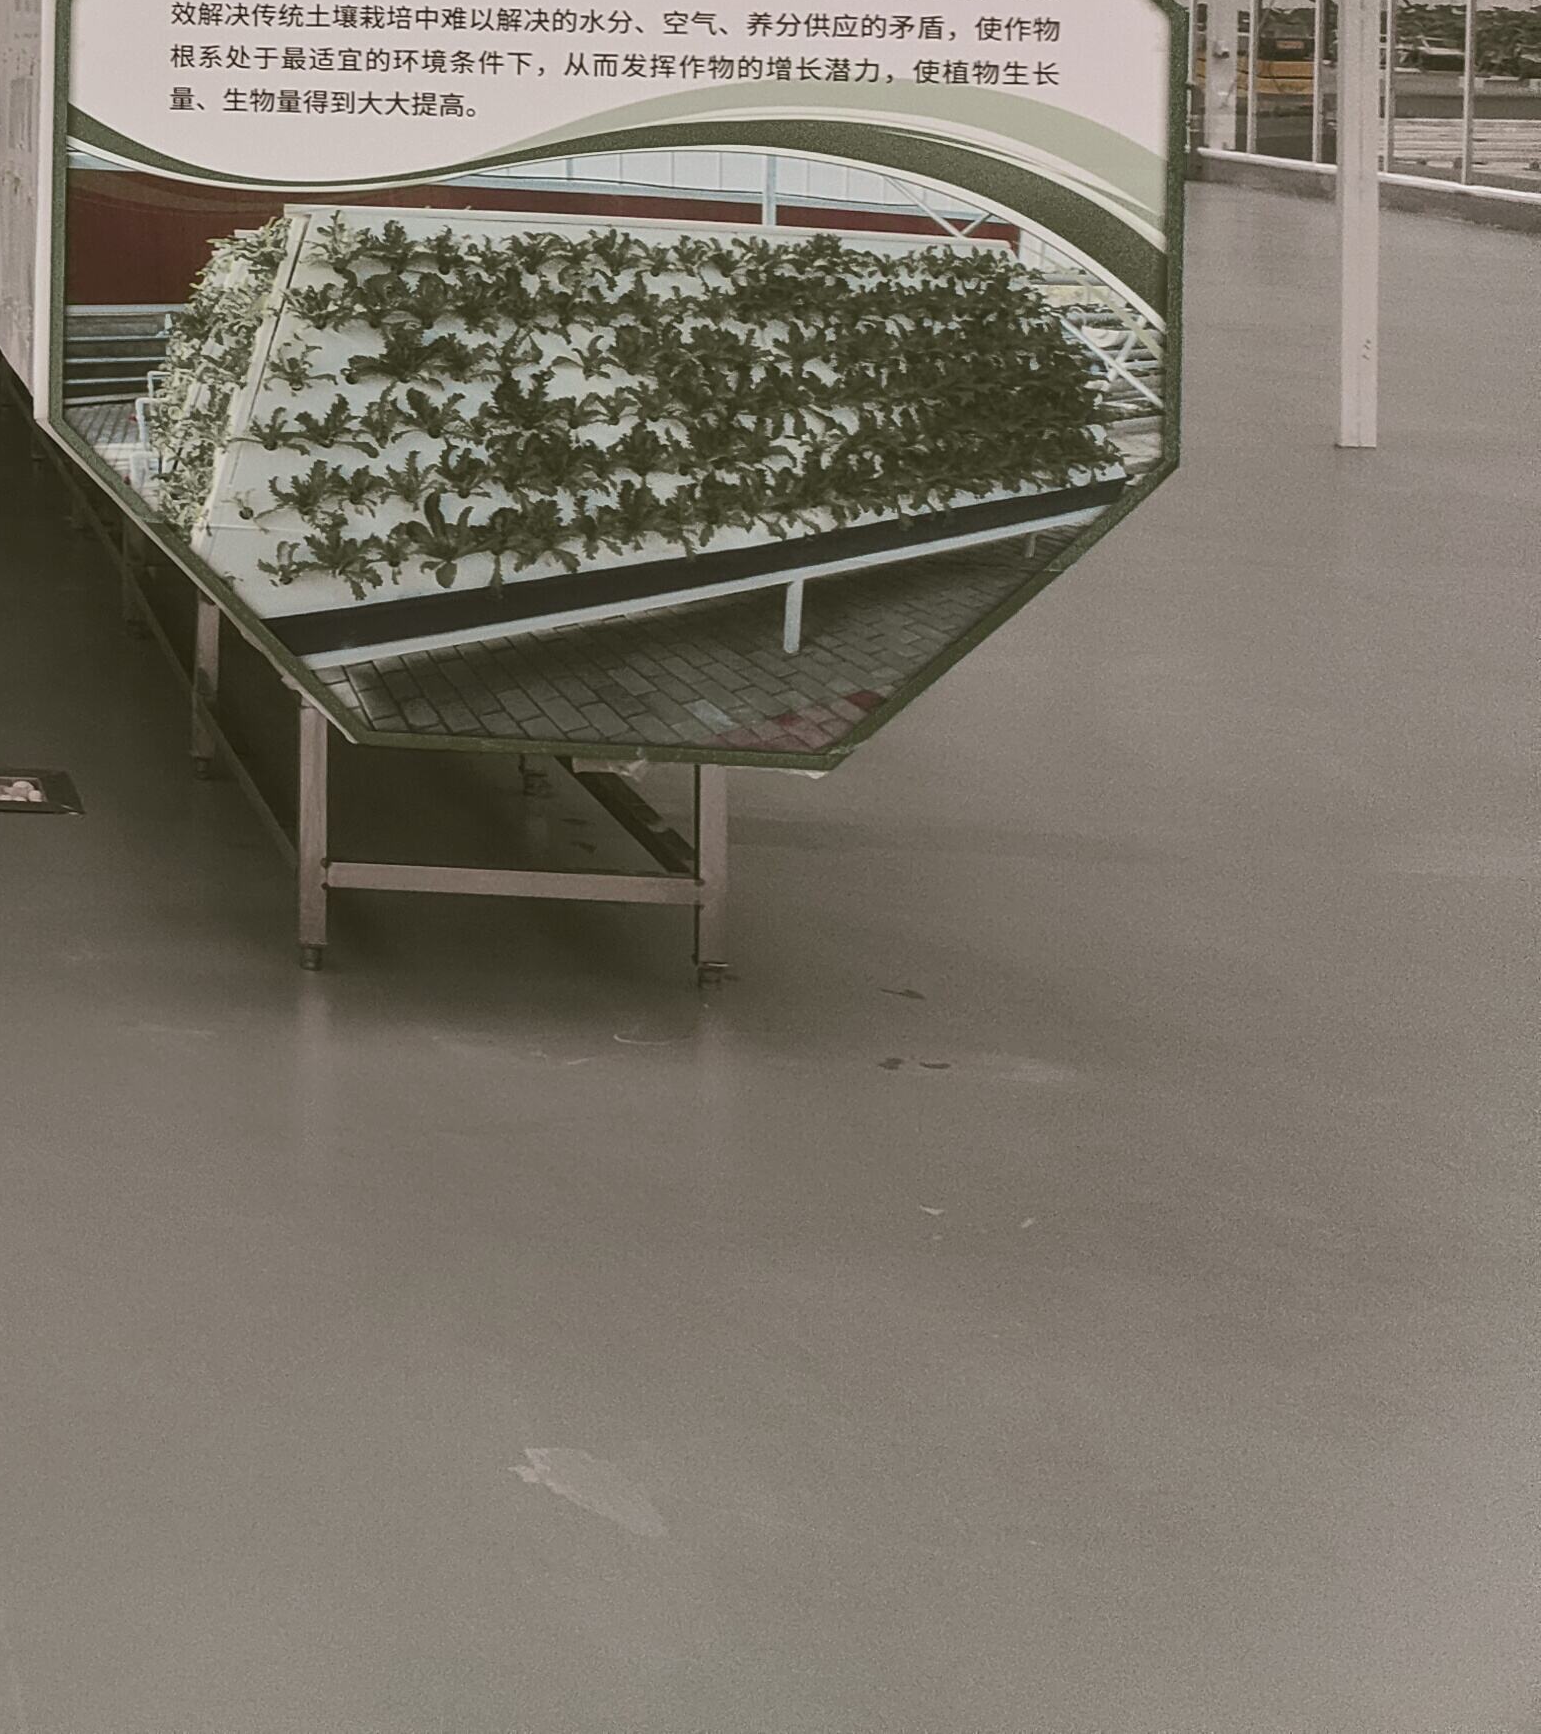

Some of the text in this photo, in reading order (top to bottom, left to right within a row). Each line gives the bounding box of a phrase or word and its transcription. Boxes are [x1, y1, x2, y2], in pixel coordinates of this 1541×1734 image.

[170, 1, 1061, 43] 效解决传统土壤栽培中难以解决的水分、空气、养分供应的矛盾，使作物
[169, 44, 1061, 87] 根系处于最适宜的环境条件下，从而发挥作物的增长潜力，使植物生长
[169, 86, 480, 119] 量、生物量得到大大提高。
